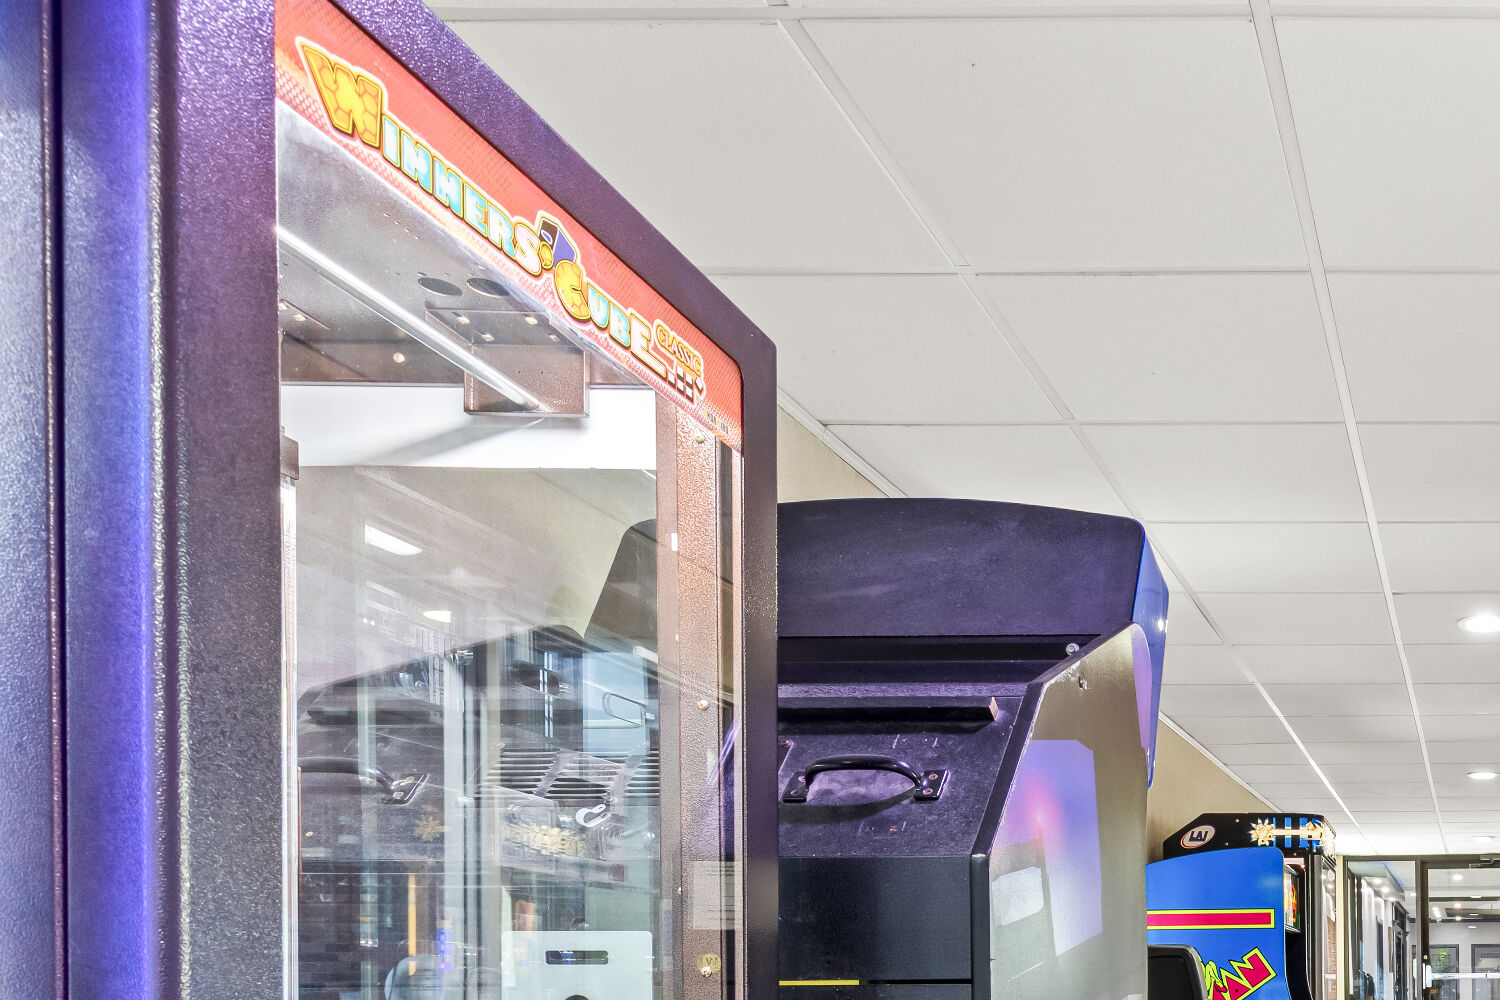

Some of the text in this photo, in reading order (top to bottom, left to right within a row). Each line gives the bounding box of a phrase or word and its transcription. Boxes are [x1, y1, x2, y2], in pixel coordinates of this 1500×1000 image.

[554, 259, 667, 377] CUBE
[656, 324, 702, 377] CLASSIC
[1188, 830, 1209, 843] LAI
